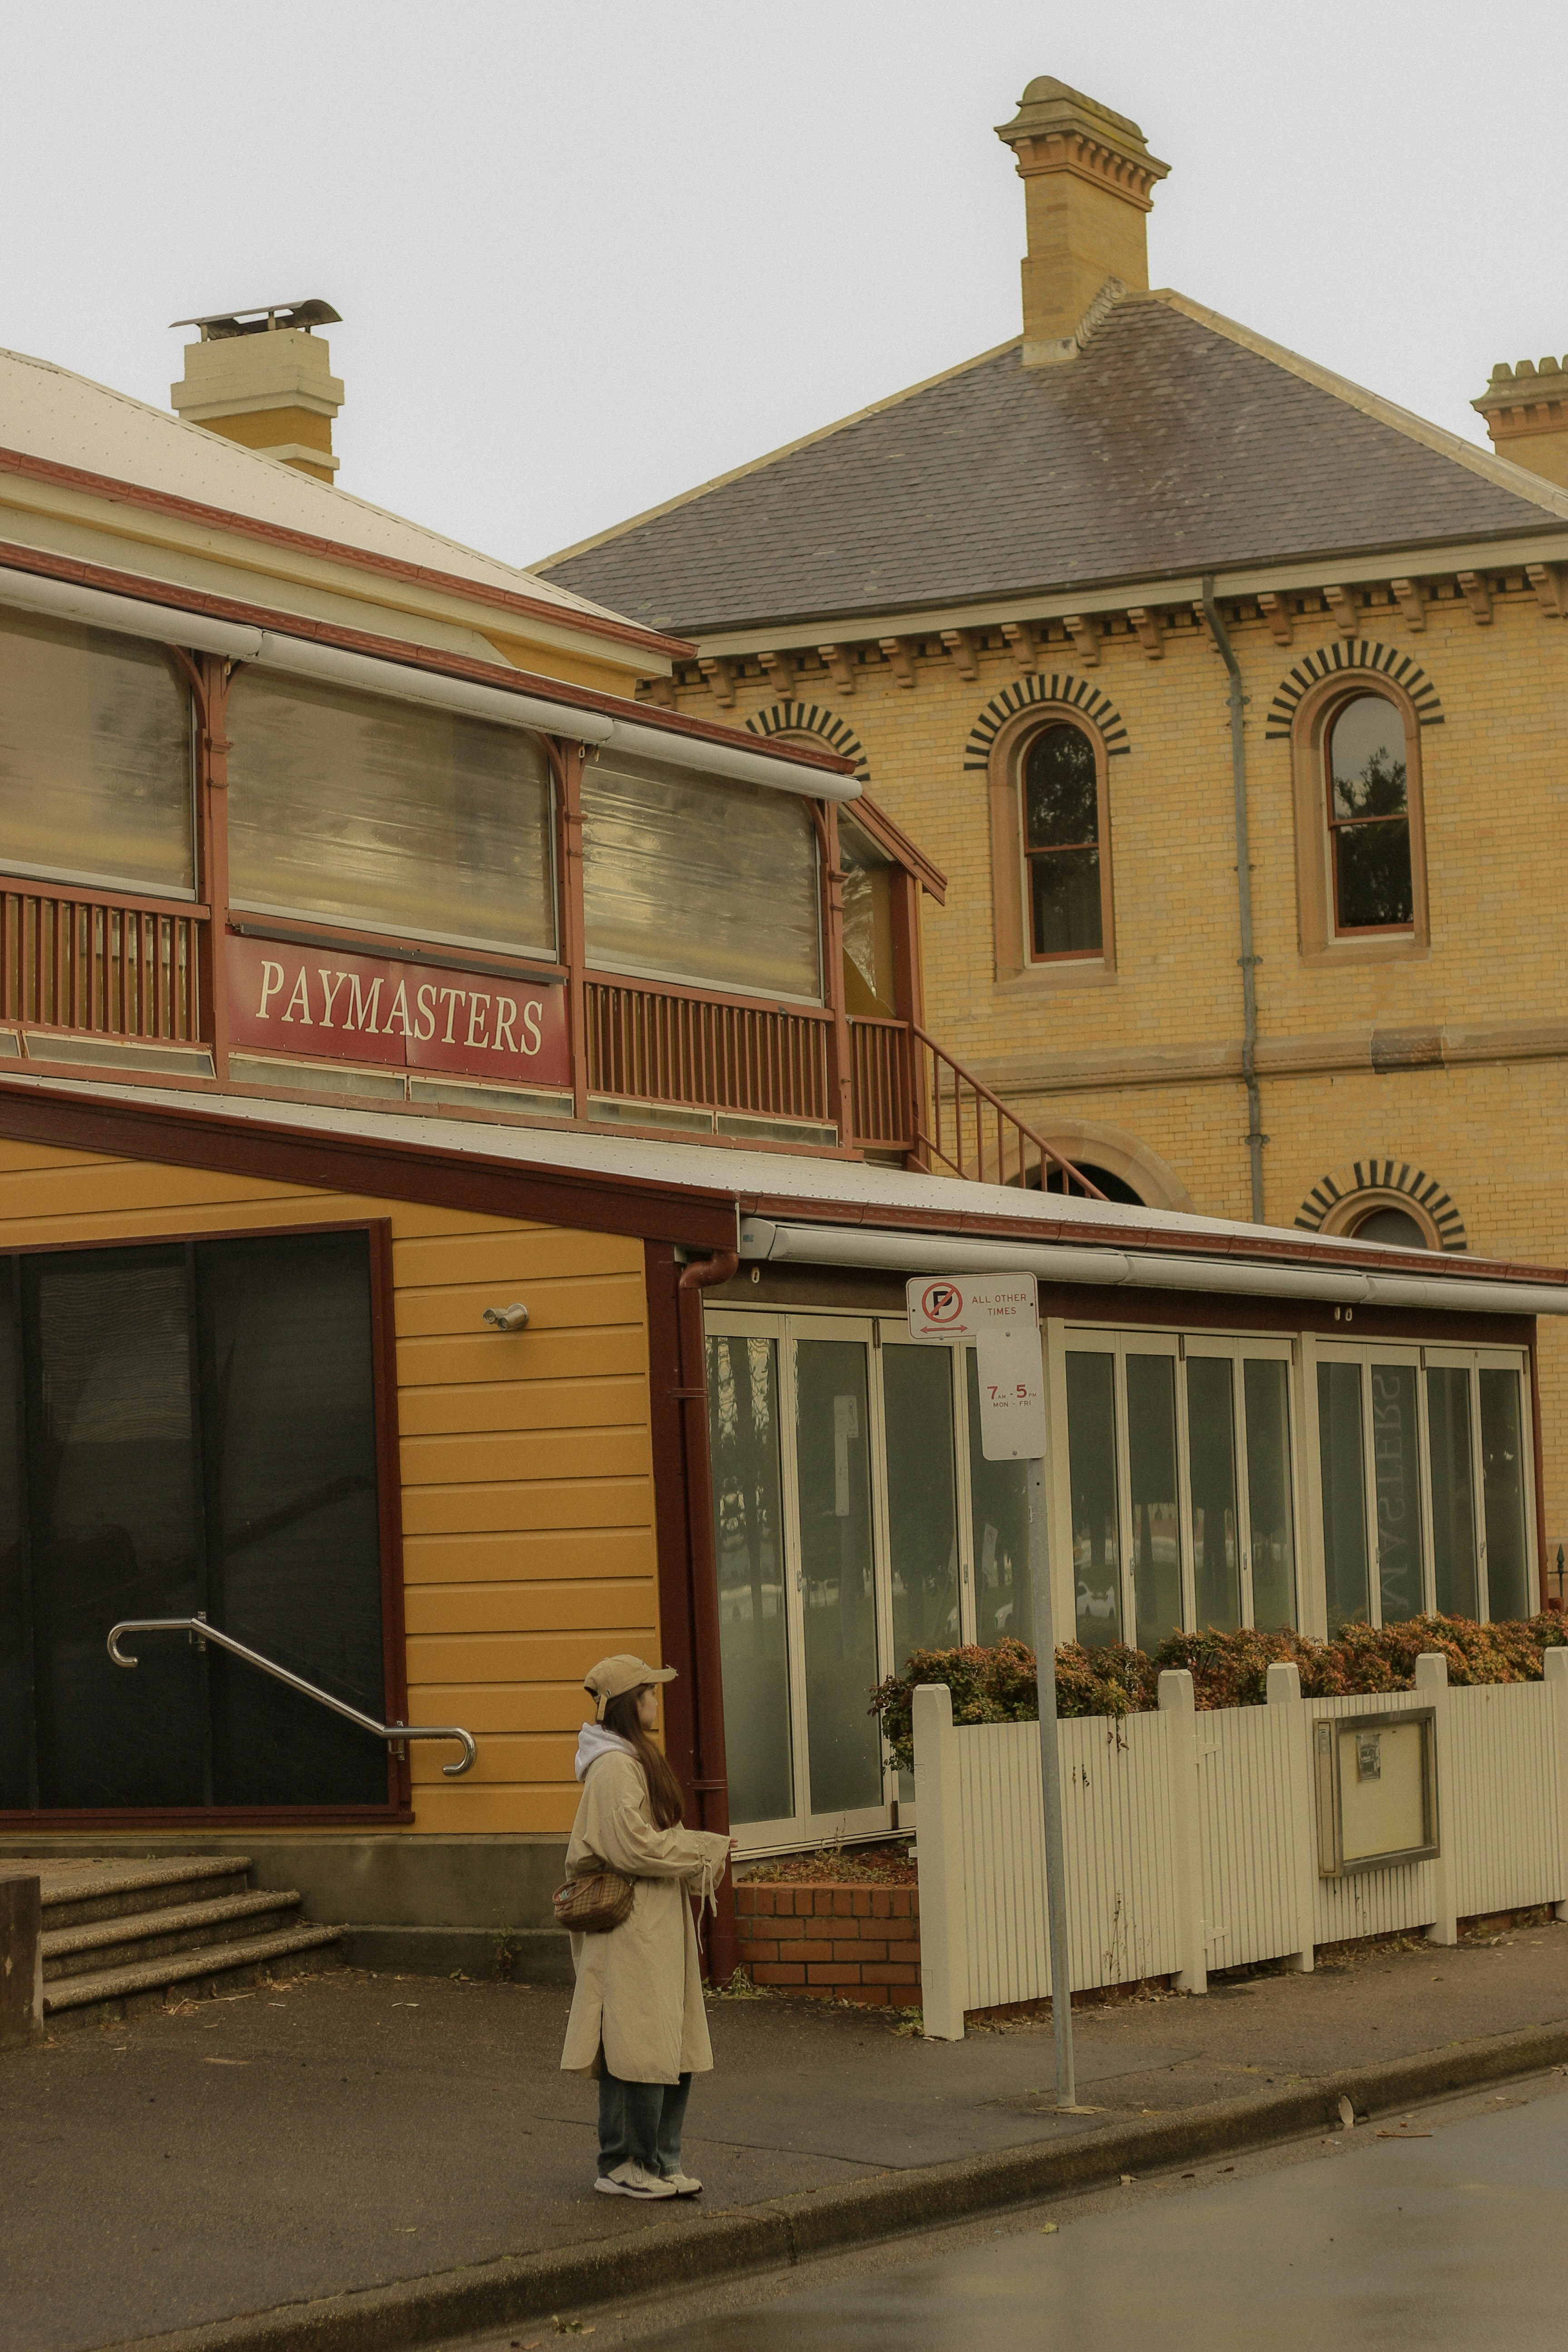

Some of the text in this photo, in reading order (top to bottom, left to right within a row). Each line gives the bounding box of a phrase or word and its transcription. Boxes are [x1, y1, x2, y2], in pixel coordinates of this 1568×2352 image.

[255, 960, 543, 1056] PAYMASTERS
[995, 1294, 1026, 1302] OTHER
[987, 1307, 1016, 1315] TIMES
